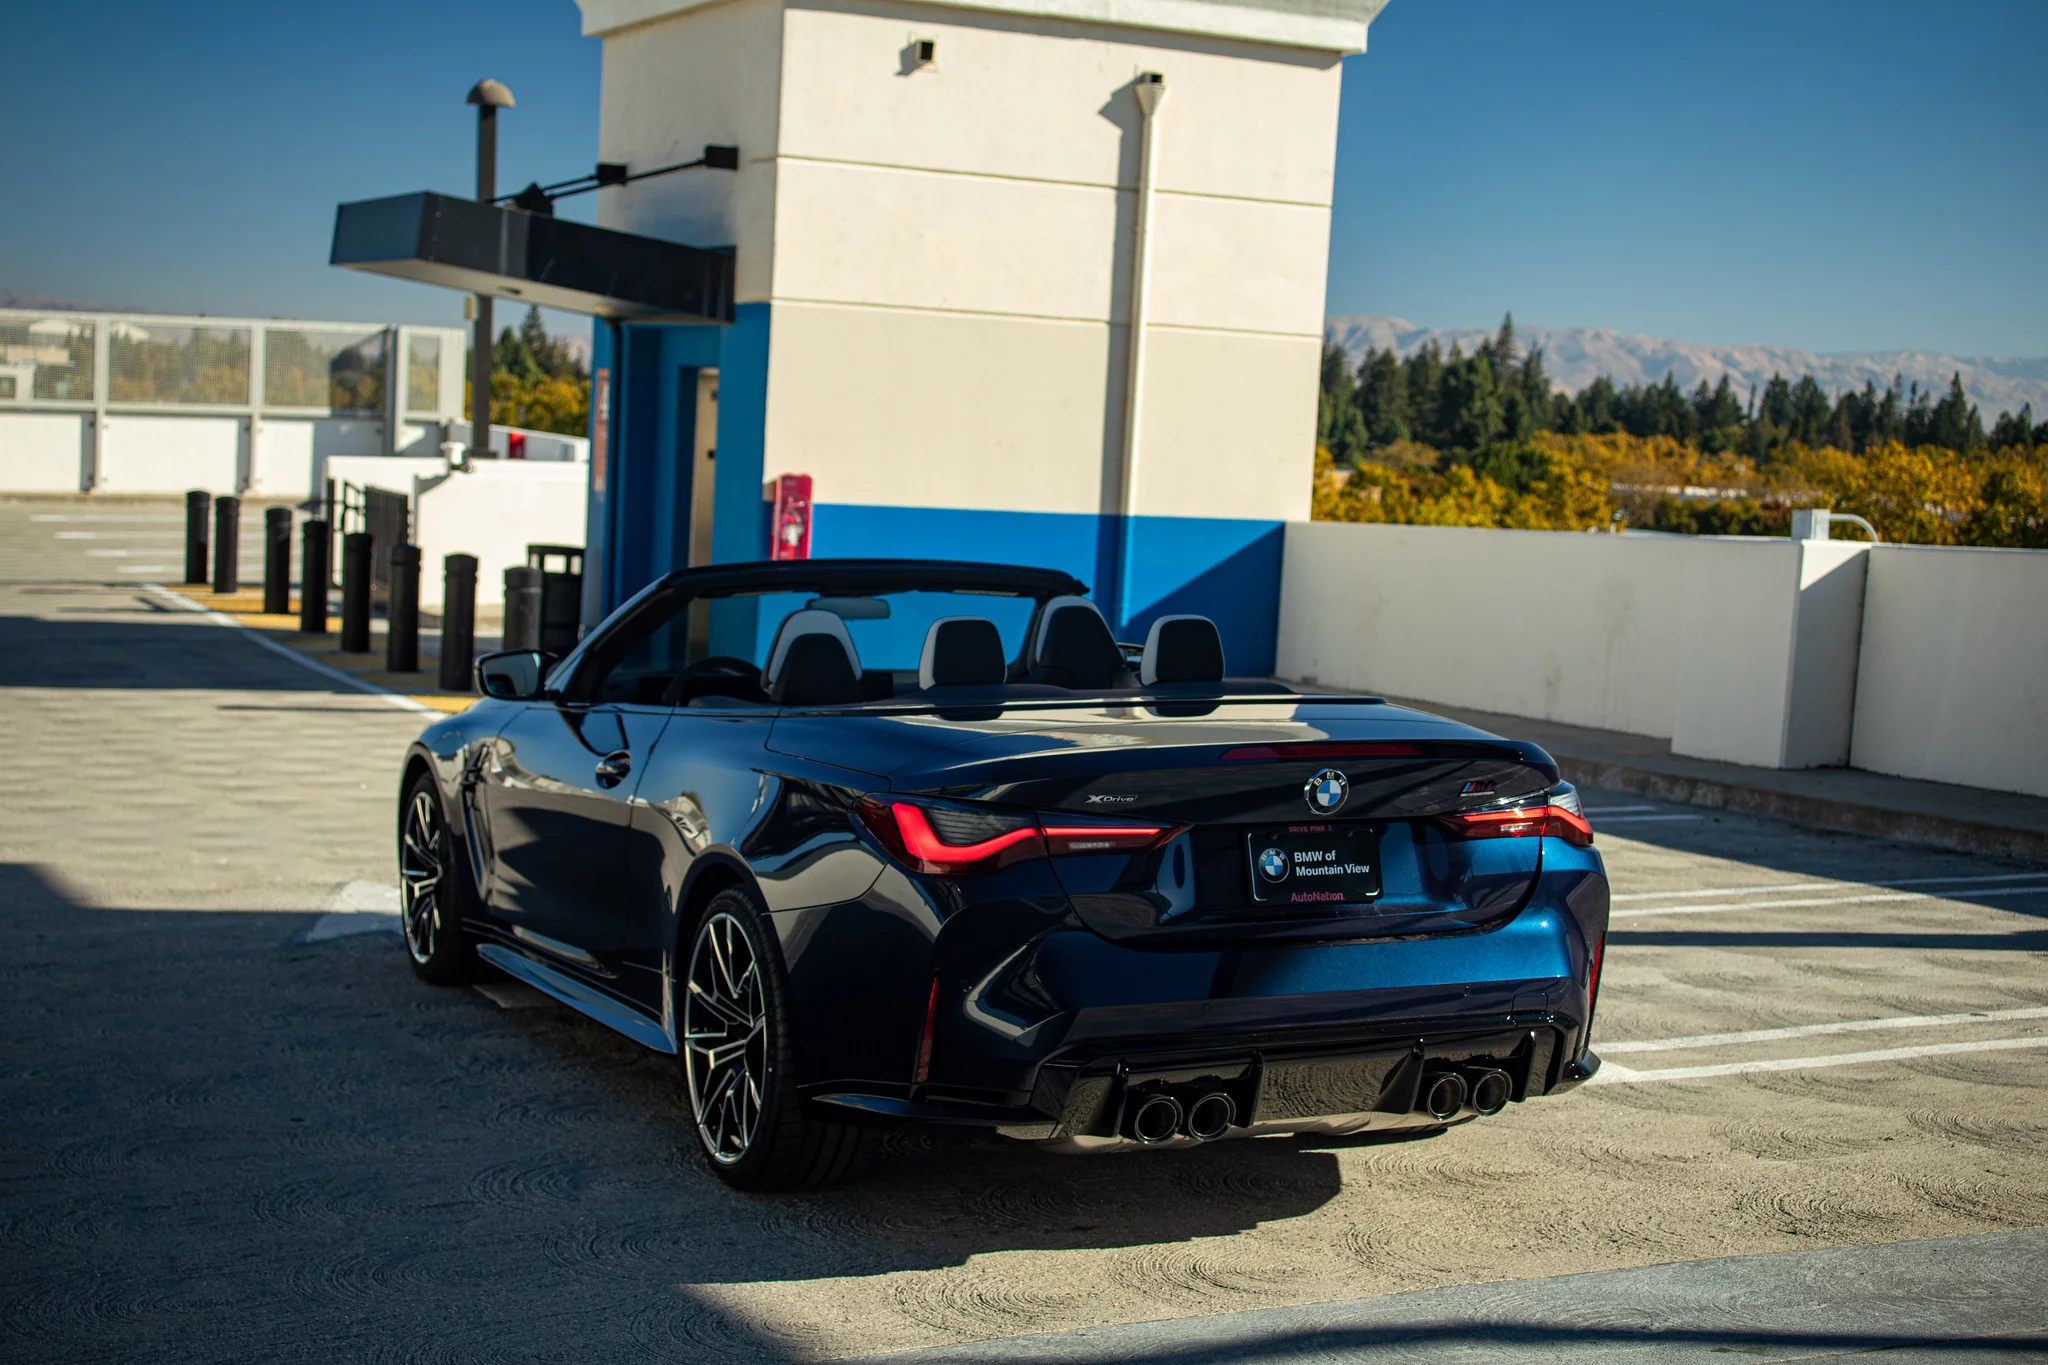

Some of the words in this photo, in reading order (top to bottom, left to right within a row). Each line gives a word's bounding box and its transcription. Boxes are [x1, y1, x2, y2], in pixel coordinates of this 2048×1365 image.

[1313, 771, 1346, 786] BMW
[1288, 825, 1309, 833] DRIVE
[1261, 849, 1286, 861] BMW
[1294, 851, 1322, 863] BMW
[1325, 850, 1336, 860] of
[1295, 865, 1343, 877] Mountain
[1344, 863, 1370, 874] View
[1290, 891, 1344, 903] AutoNation
